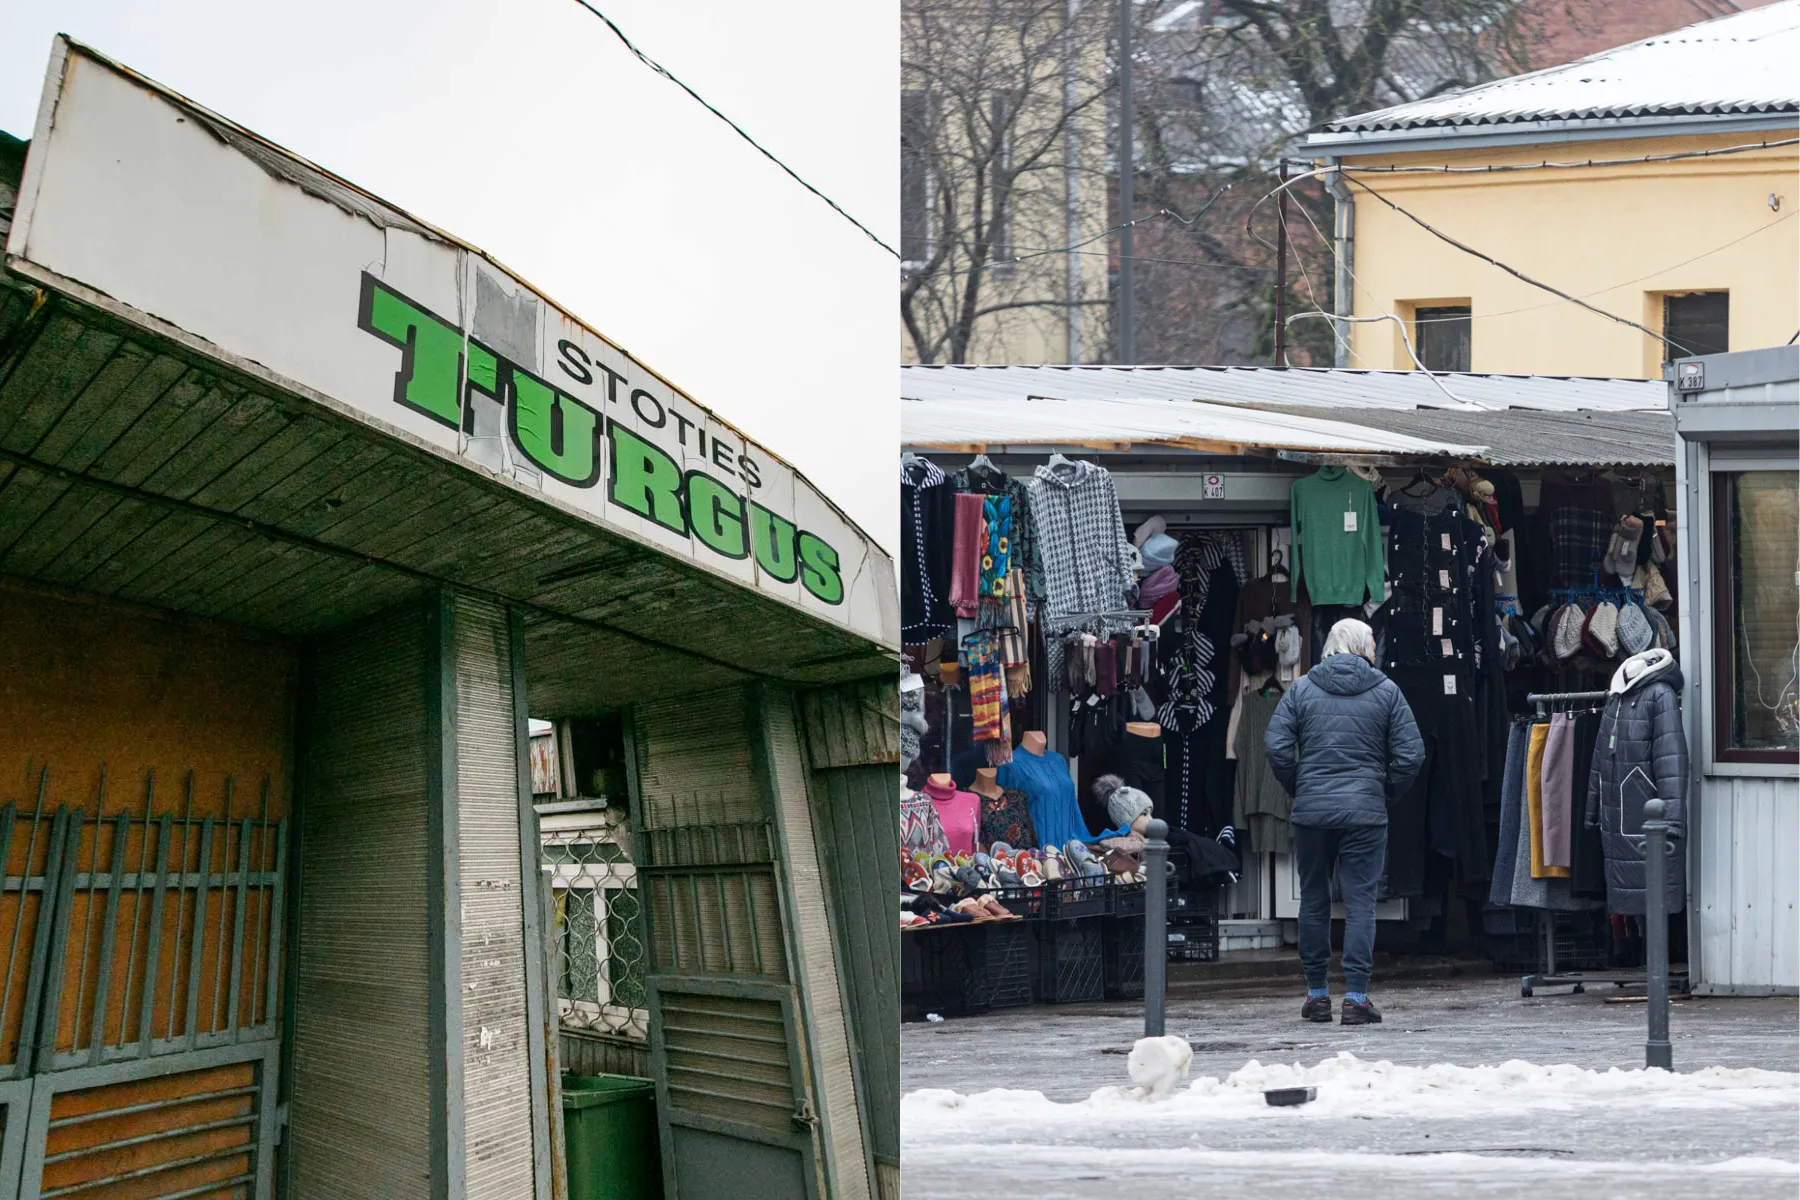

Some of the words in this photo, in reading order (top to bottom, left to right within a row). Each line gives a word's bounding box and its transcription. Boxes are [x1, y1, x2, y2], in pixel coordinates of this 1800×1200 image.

[557, 338, 763, 489] STOTIES
[1688, 376, 1702, 387] 387
[357, 270, 845, 606] TURGUS
[1211, 486, 1223, 497] 407
